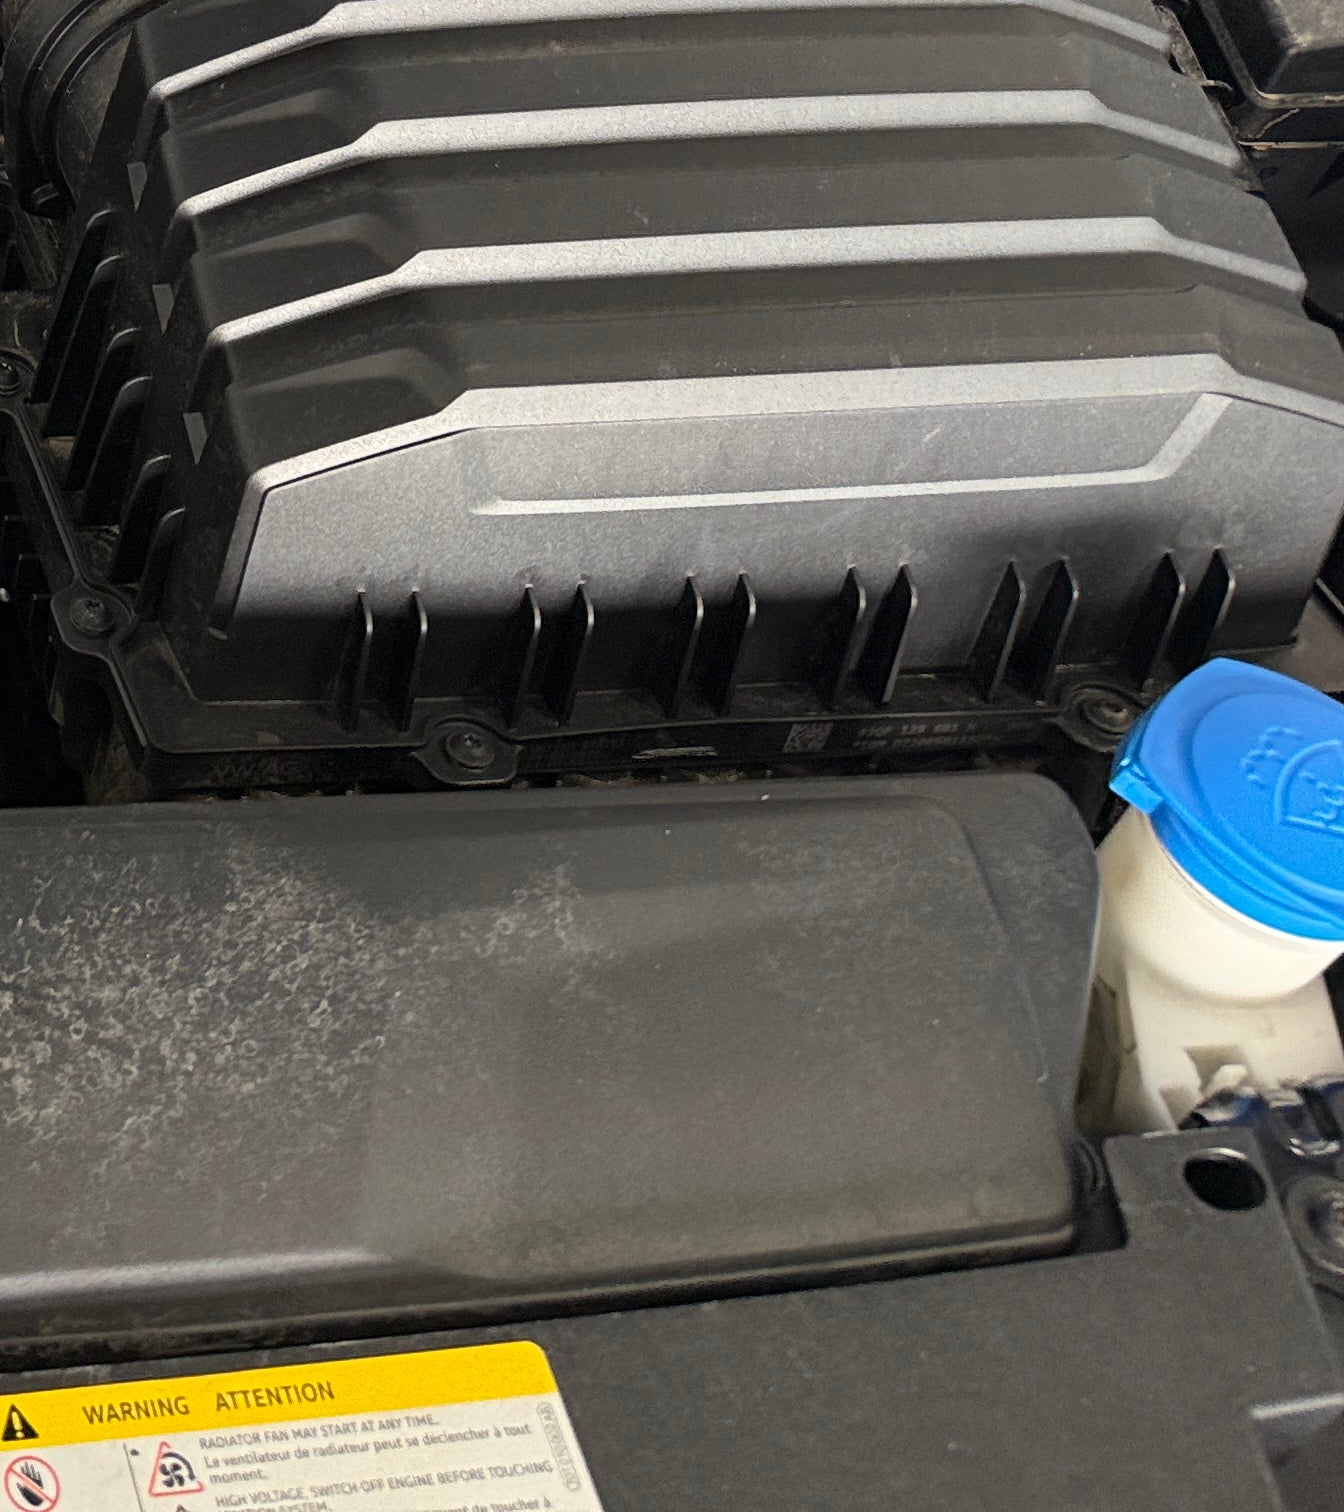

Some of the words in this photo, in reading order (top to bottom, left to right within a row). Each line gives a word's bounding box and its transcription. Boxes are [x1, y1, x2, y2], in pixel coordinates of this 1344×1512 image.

[82, 1396, 190, 1425] WARNING
[216, 1381, 335, 1412] ATTENTION
[199, 1430, 261, 1450] RADIATOR
[263, 1428, 289, 1445] FAN
[291, 1426, 318, 1443] MAY
[323, 1421, 357, 1438] START
[361, 1419, 375, 1433] AT
[378, 1418, 402, 1431] ANY
[223, 1448, 292, 1466] ventilateur
[294, 1445, 310, 1460] de
[313, 1441, 369, 1457] radiateur
[374, 1437, 403, 1455] peut
[406, 1436, 420, 1448] se
[423, 1426, 490, 1446] déclencher
[504, 1422, 531, 1436] tout
[209, 1469, 268, 1484] moment.
[215, 1493, 247, 1507] HIGH
[310, 1482, 357, 1498] SWITCH
[360, 1478, 386, 1494] OFF
[387, 1473, 433, 1489] ENGINE
[436, 1468, 485, 1485] BEFORE
[488, 1460, 554, 1479] TOUCHING
